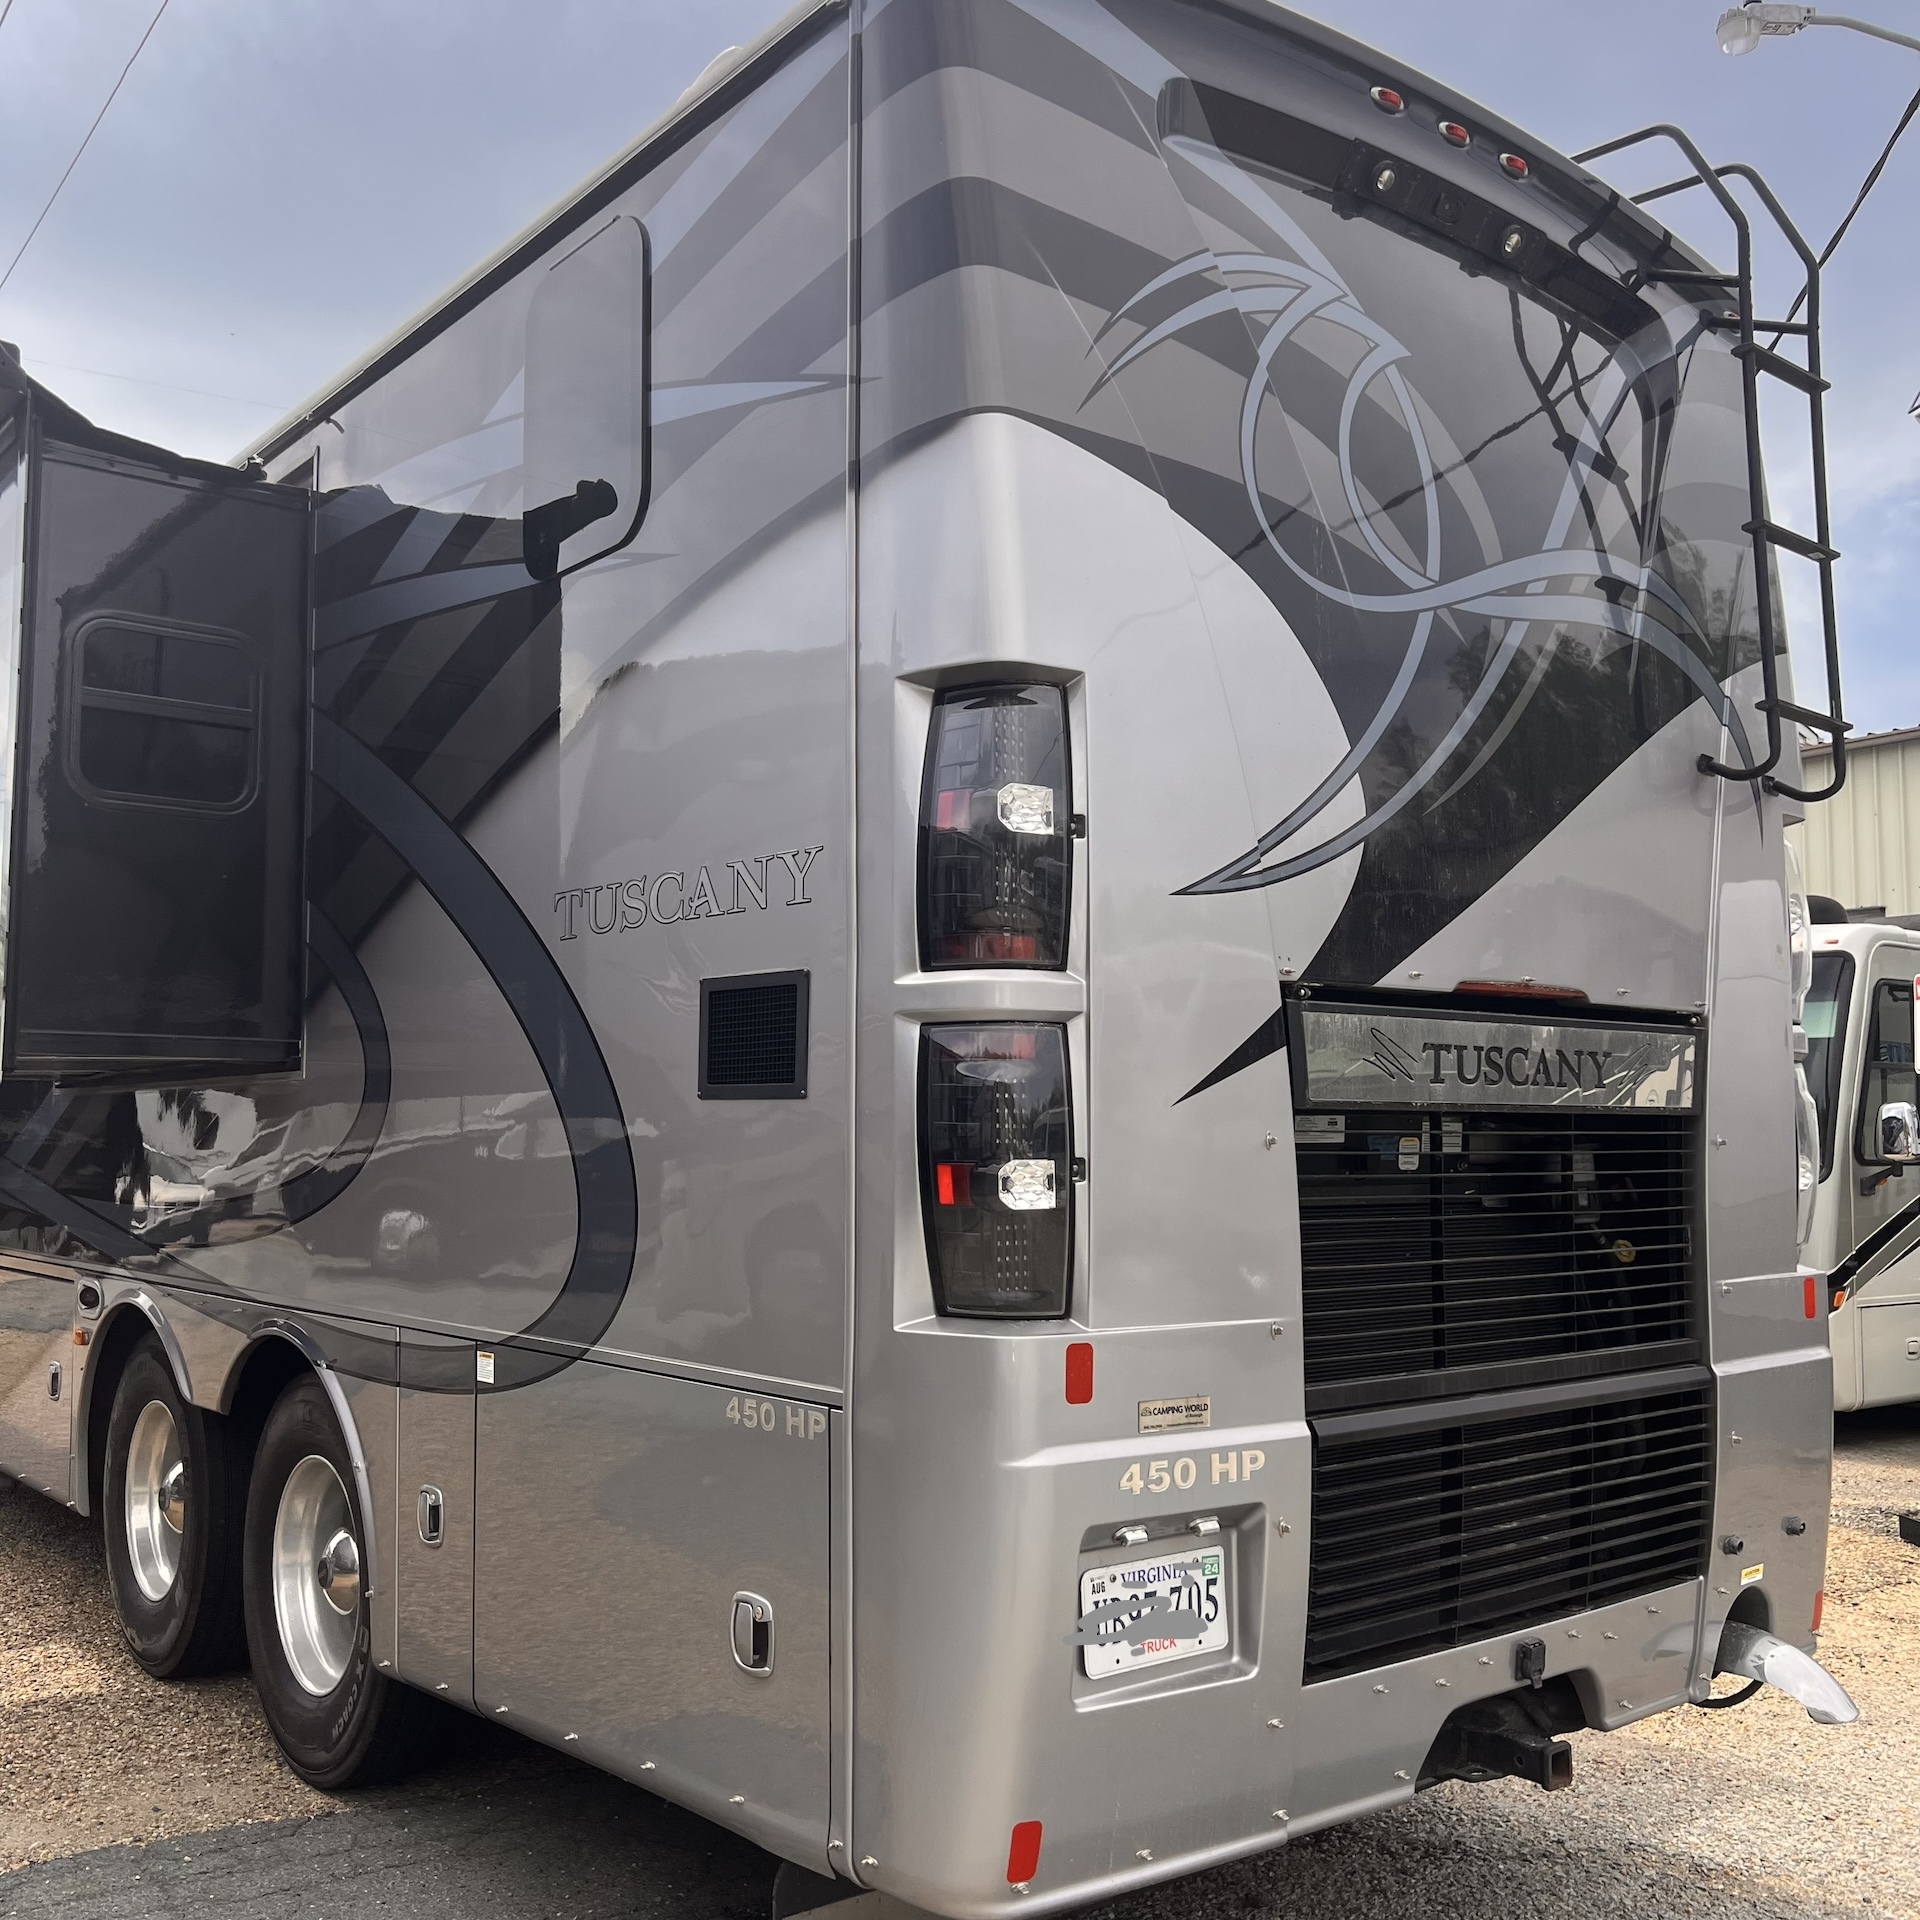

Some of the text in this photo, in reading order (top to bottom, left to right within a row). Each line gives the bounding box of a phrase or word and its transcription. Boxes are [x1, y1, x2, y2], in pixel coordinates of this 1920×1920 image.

[554, 845, 824, 941] TUSCANY
[1422, 1042, 1613, 1090] TUSCANY
[726, 1396, 826, 1440] 450 HP
[1153, 1405, 1183, 1416] CAMPING
[1184, 1403, 1209, 1413] WORLD
[1119, 1449, 1266, 1495] 450 HP
[1204, 1564, 1218, 1575] 24
[1091, 1581, 1106, 1595] AUG
[1140, 1638, 1177, 1654] TRUCK
